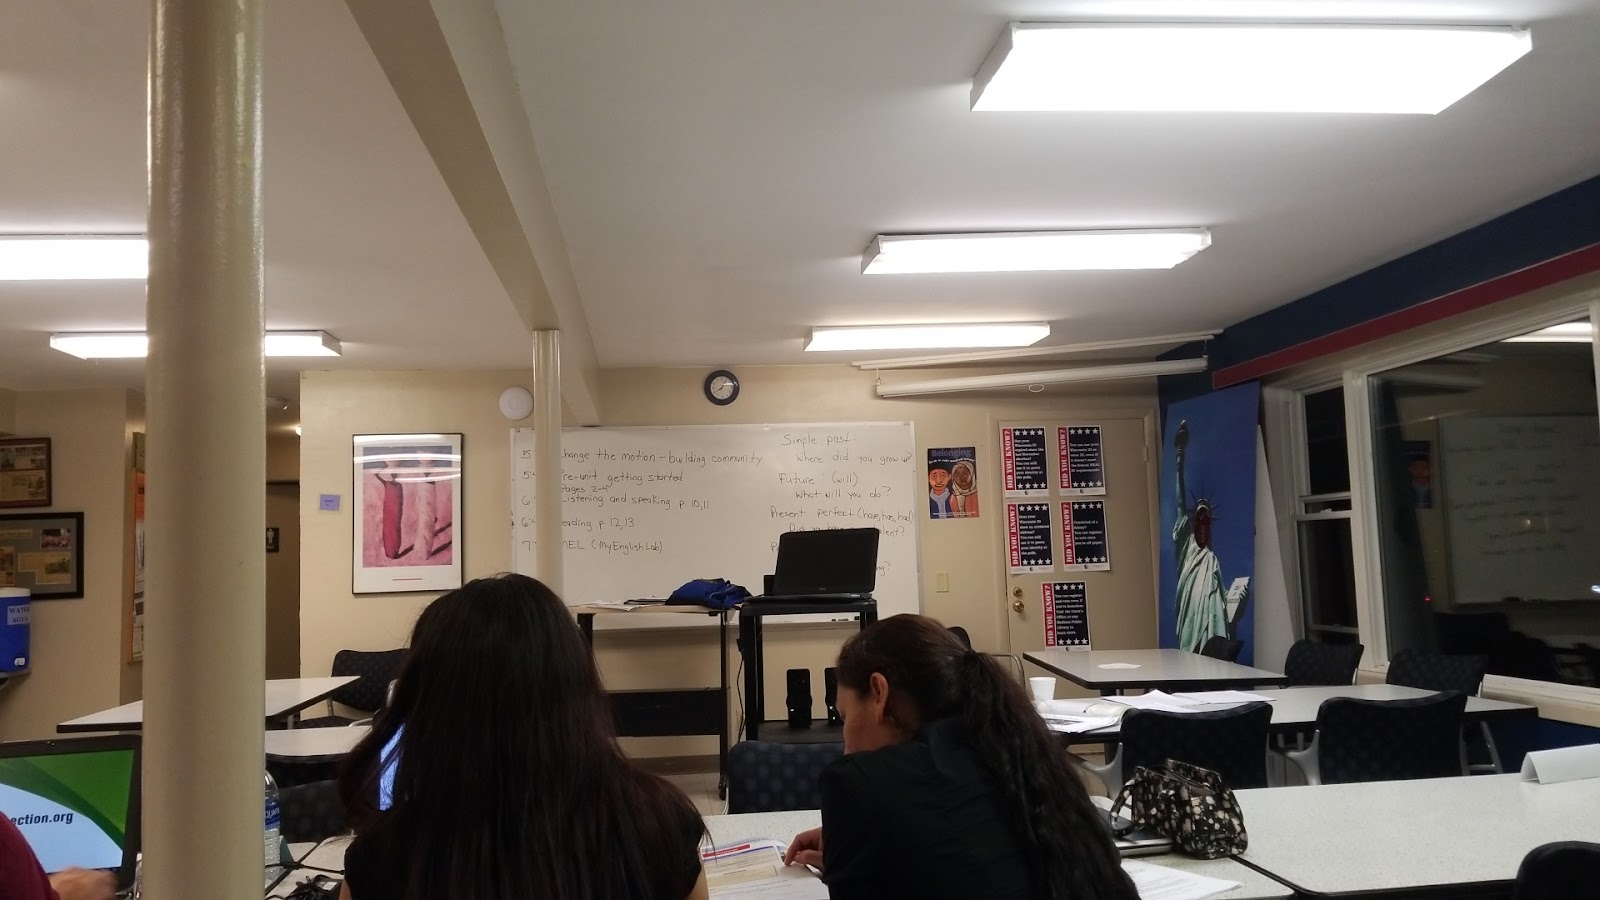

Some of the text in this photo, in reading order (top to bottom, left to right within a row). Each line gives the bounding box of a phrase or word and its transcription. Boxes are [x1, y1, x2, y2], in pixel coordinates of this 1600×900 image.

[781, 432, 817, 448] Simple
[1004, 430, 1012, 457] KNOW?
[561, 449, 589, 463] hange
[596, 449, 616, 460] the
[622, 449, 656, 462] motion
[668, 450, 706, 468] building
[711, 451, 763, 467] community
[832, 448, 849, 461] did
[858, 455, 873, 463] you
[880, 456, 899, 465] grow
[931, 448, 972, 458] Belonging
[606, 472, 643, 486] getting
[648, 471, 683, 482] started
[779, 472, 815, 484] Future
[825, 488, 841, 498] will
[847, 491, 861, 499] you
[610, 493, 627, 503] and
[631, 494, 671, 511] speaking
[770, 505, 806, 518] Present
[817, 506, 854, 518] perfect
[1009, 505, 1017, 533] KNOW?
[561, 517, 592, 532] eading
[1064, 532, 1072, 548] YOU
[1044, 585, 1053, 612] KNOW?
[1046, 613, 1054, 629] YOU
[10, 812, 74, 825] ection.org
